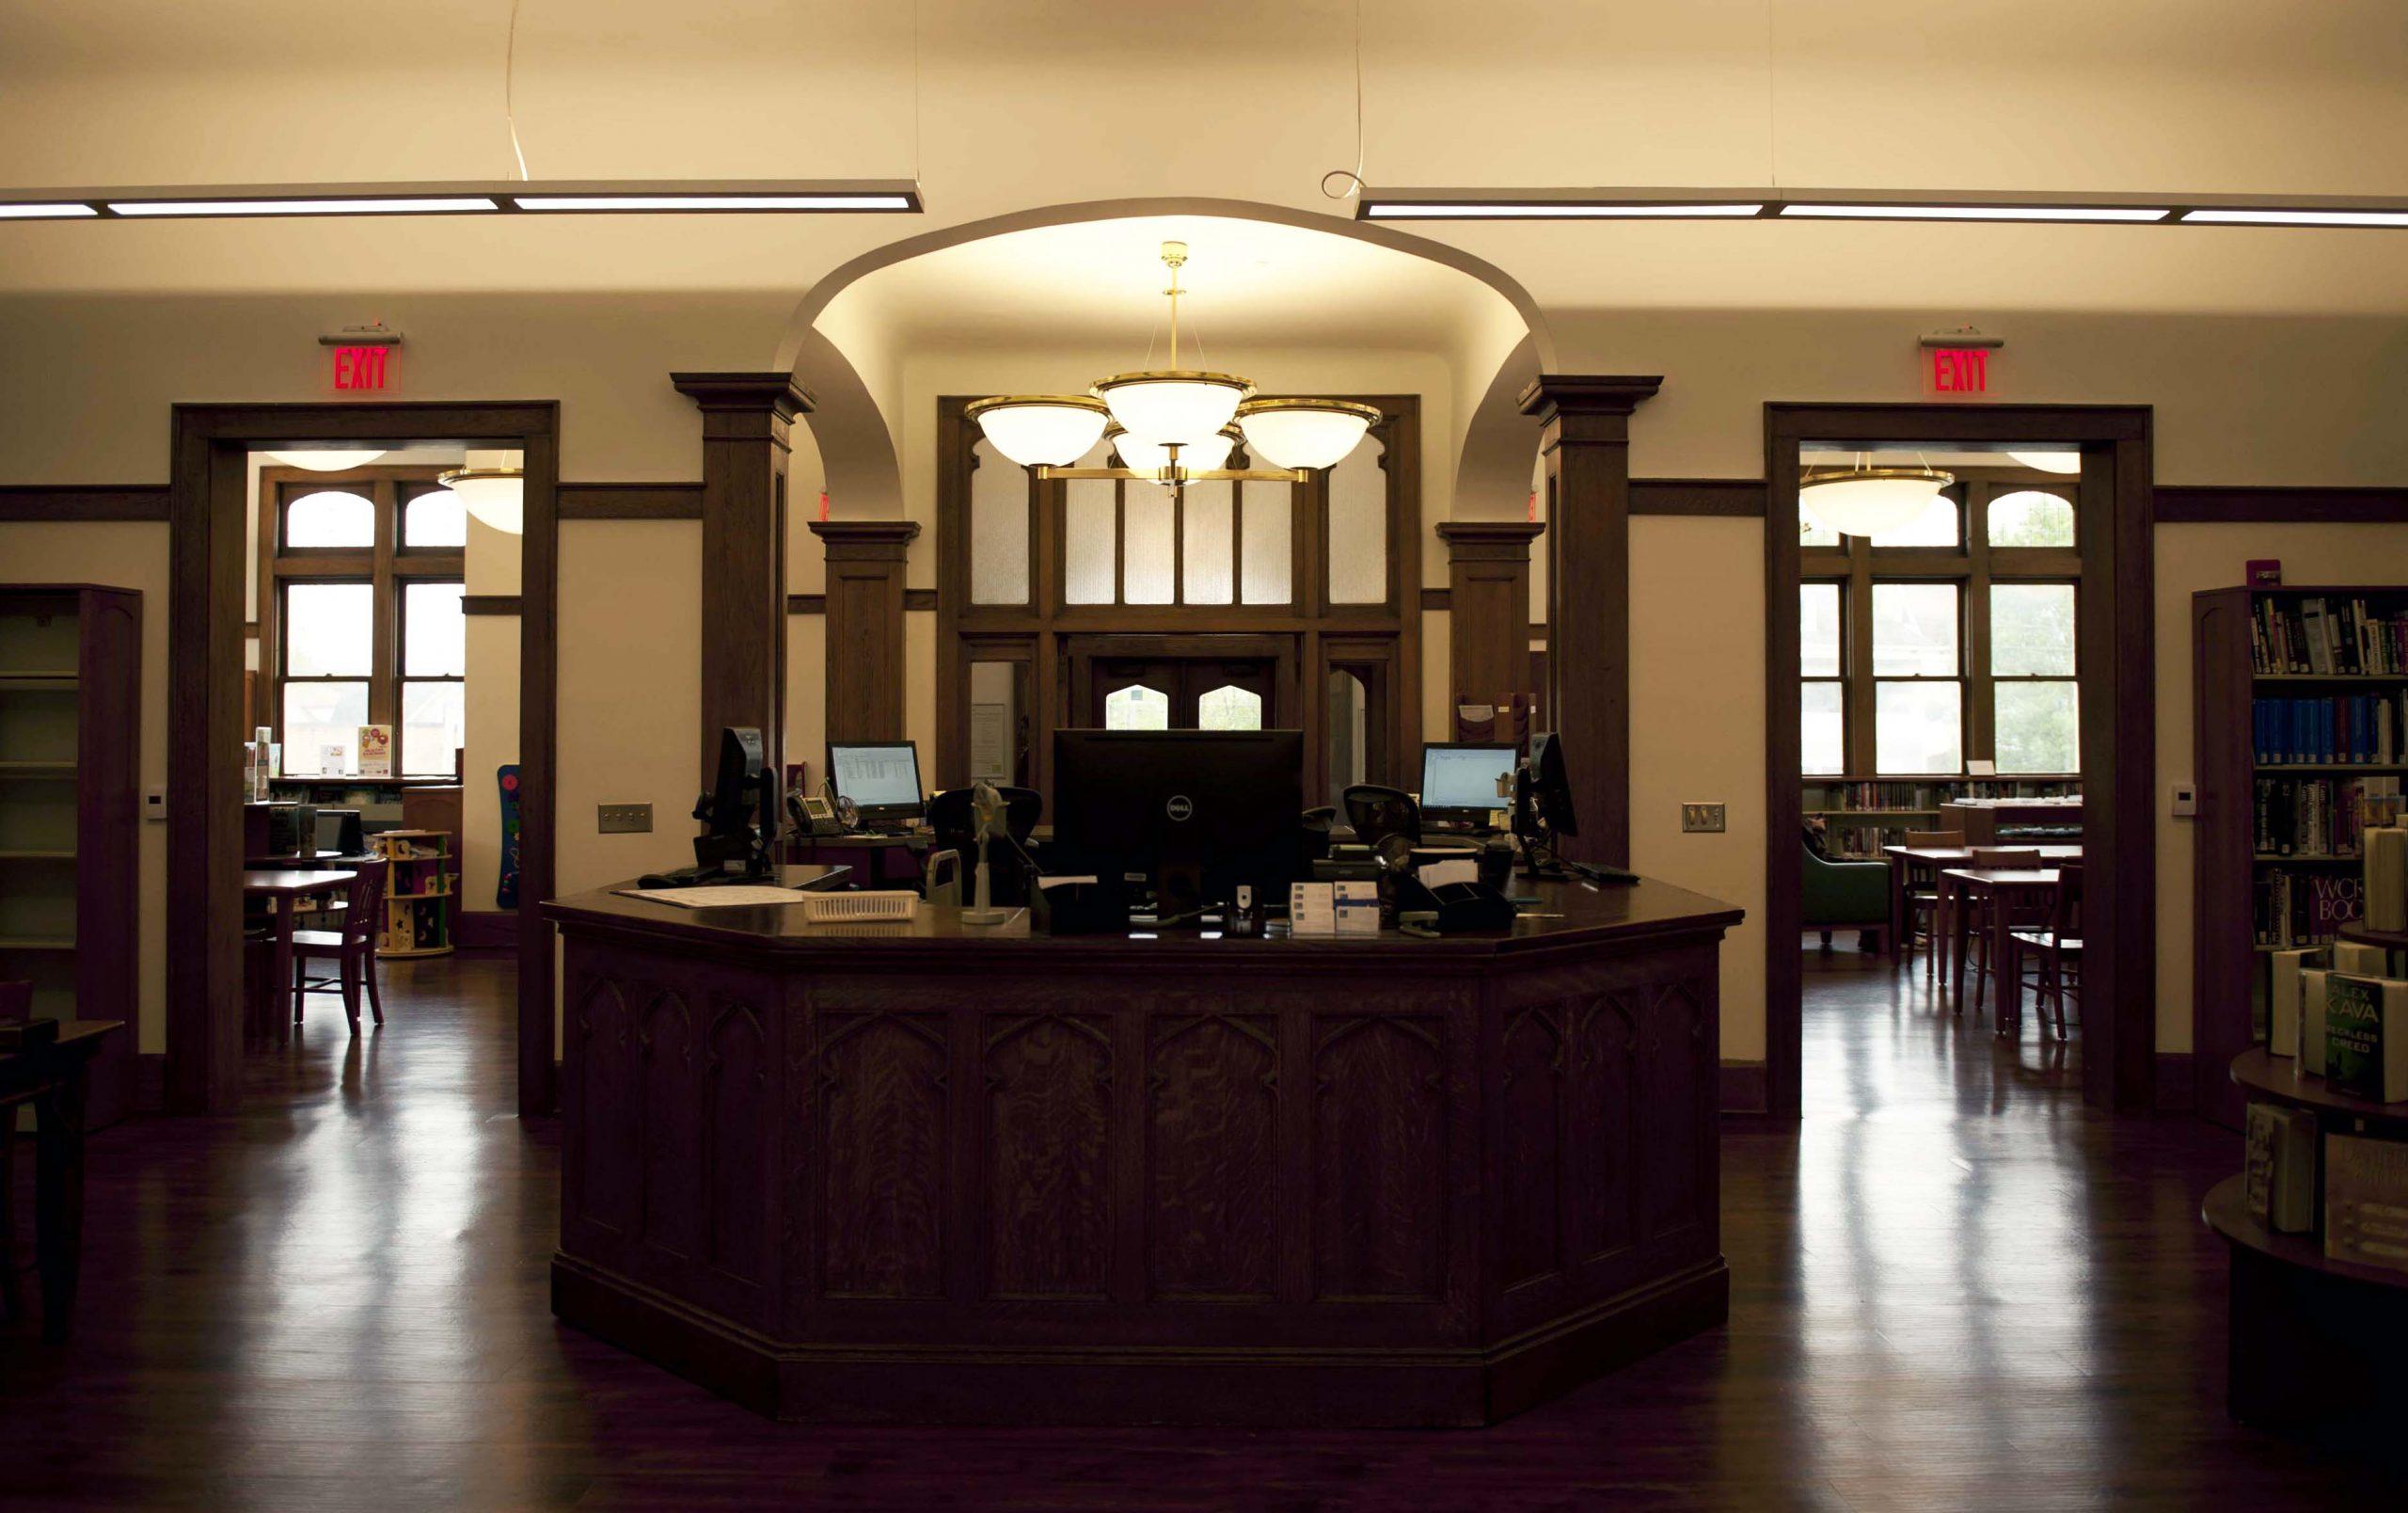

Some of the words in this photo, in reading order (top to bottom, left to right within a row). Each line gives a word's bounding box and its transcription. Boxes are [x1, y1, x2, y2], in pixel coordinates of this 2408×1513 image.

[335, 346, 388, 389] EXIT
[1935, 349, 1988, 392] EXIT
[2313, 877, 2363, 900] WOR
[2320, 894, 2363, 920] BOO
[2325, 995, 2379, 1023] KAVA
[2332, 1037, 2370, 1053] CREED
